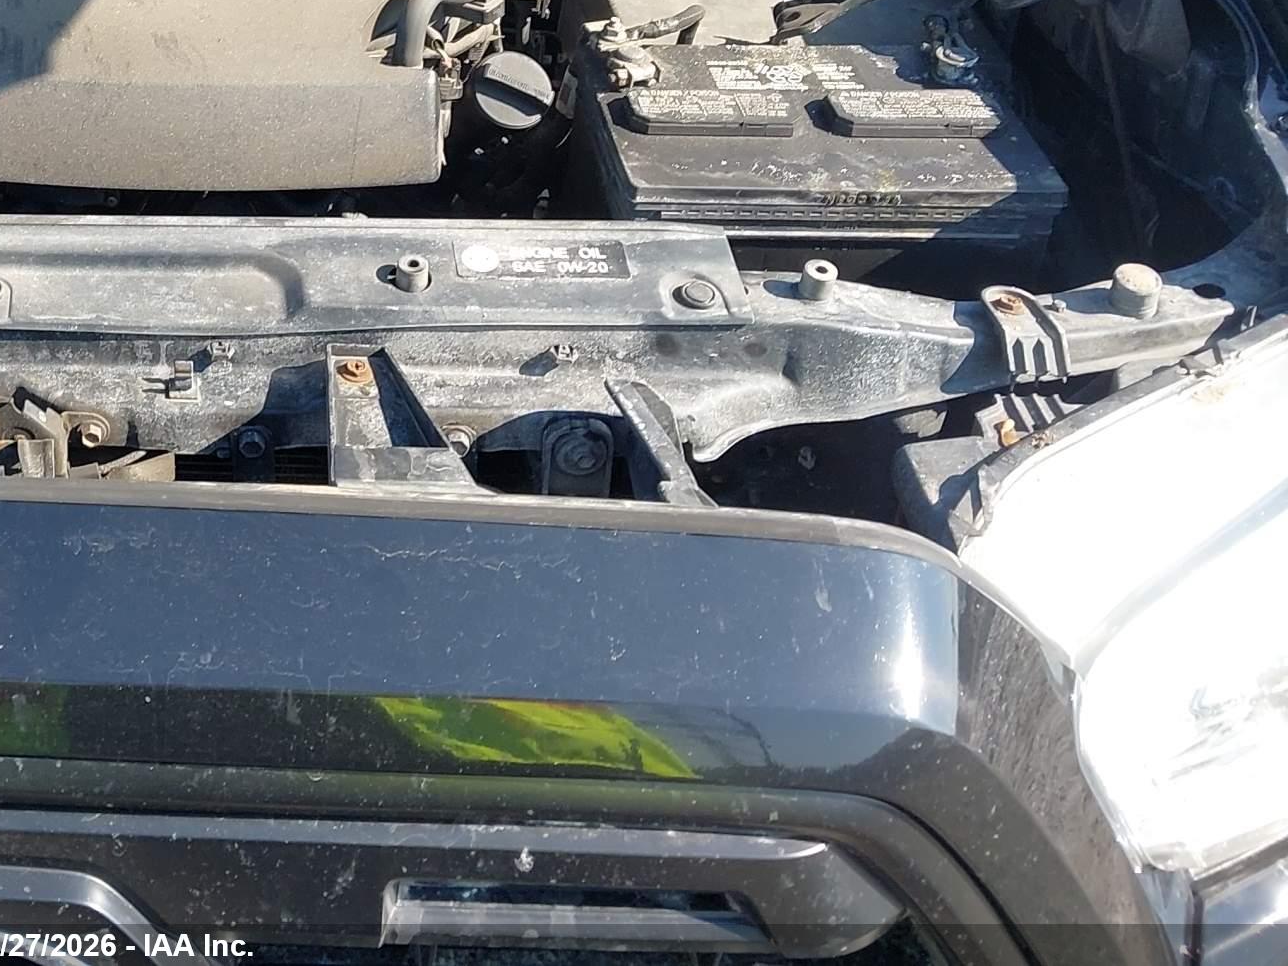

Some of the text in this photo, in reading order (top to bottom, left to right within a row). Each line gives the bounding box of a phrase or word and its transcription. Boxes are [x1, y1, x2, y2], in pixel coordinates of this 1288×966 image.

[578, 247, 607, 259] OIL
[511, 260, 609, 273] SAE 0W-20
